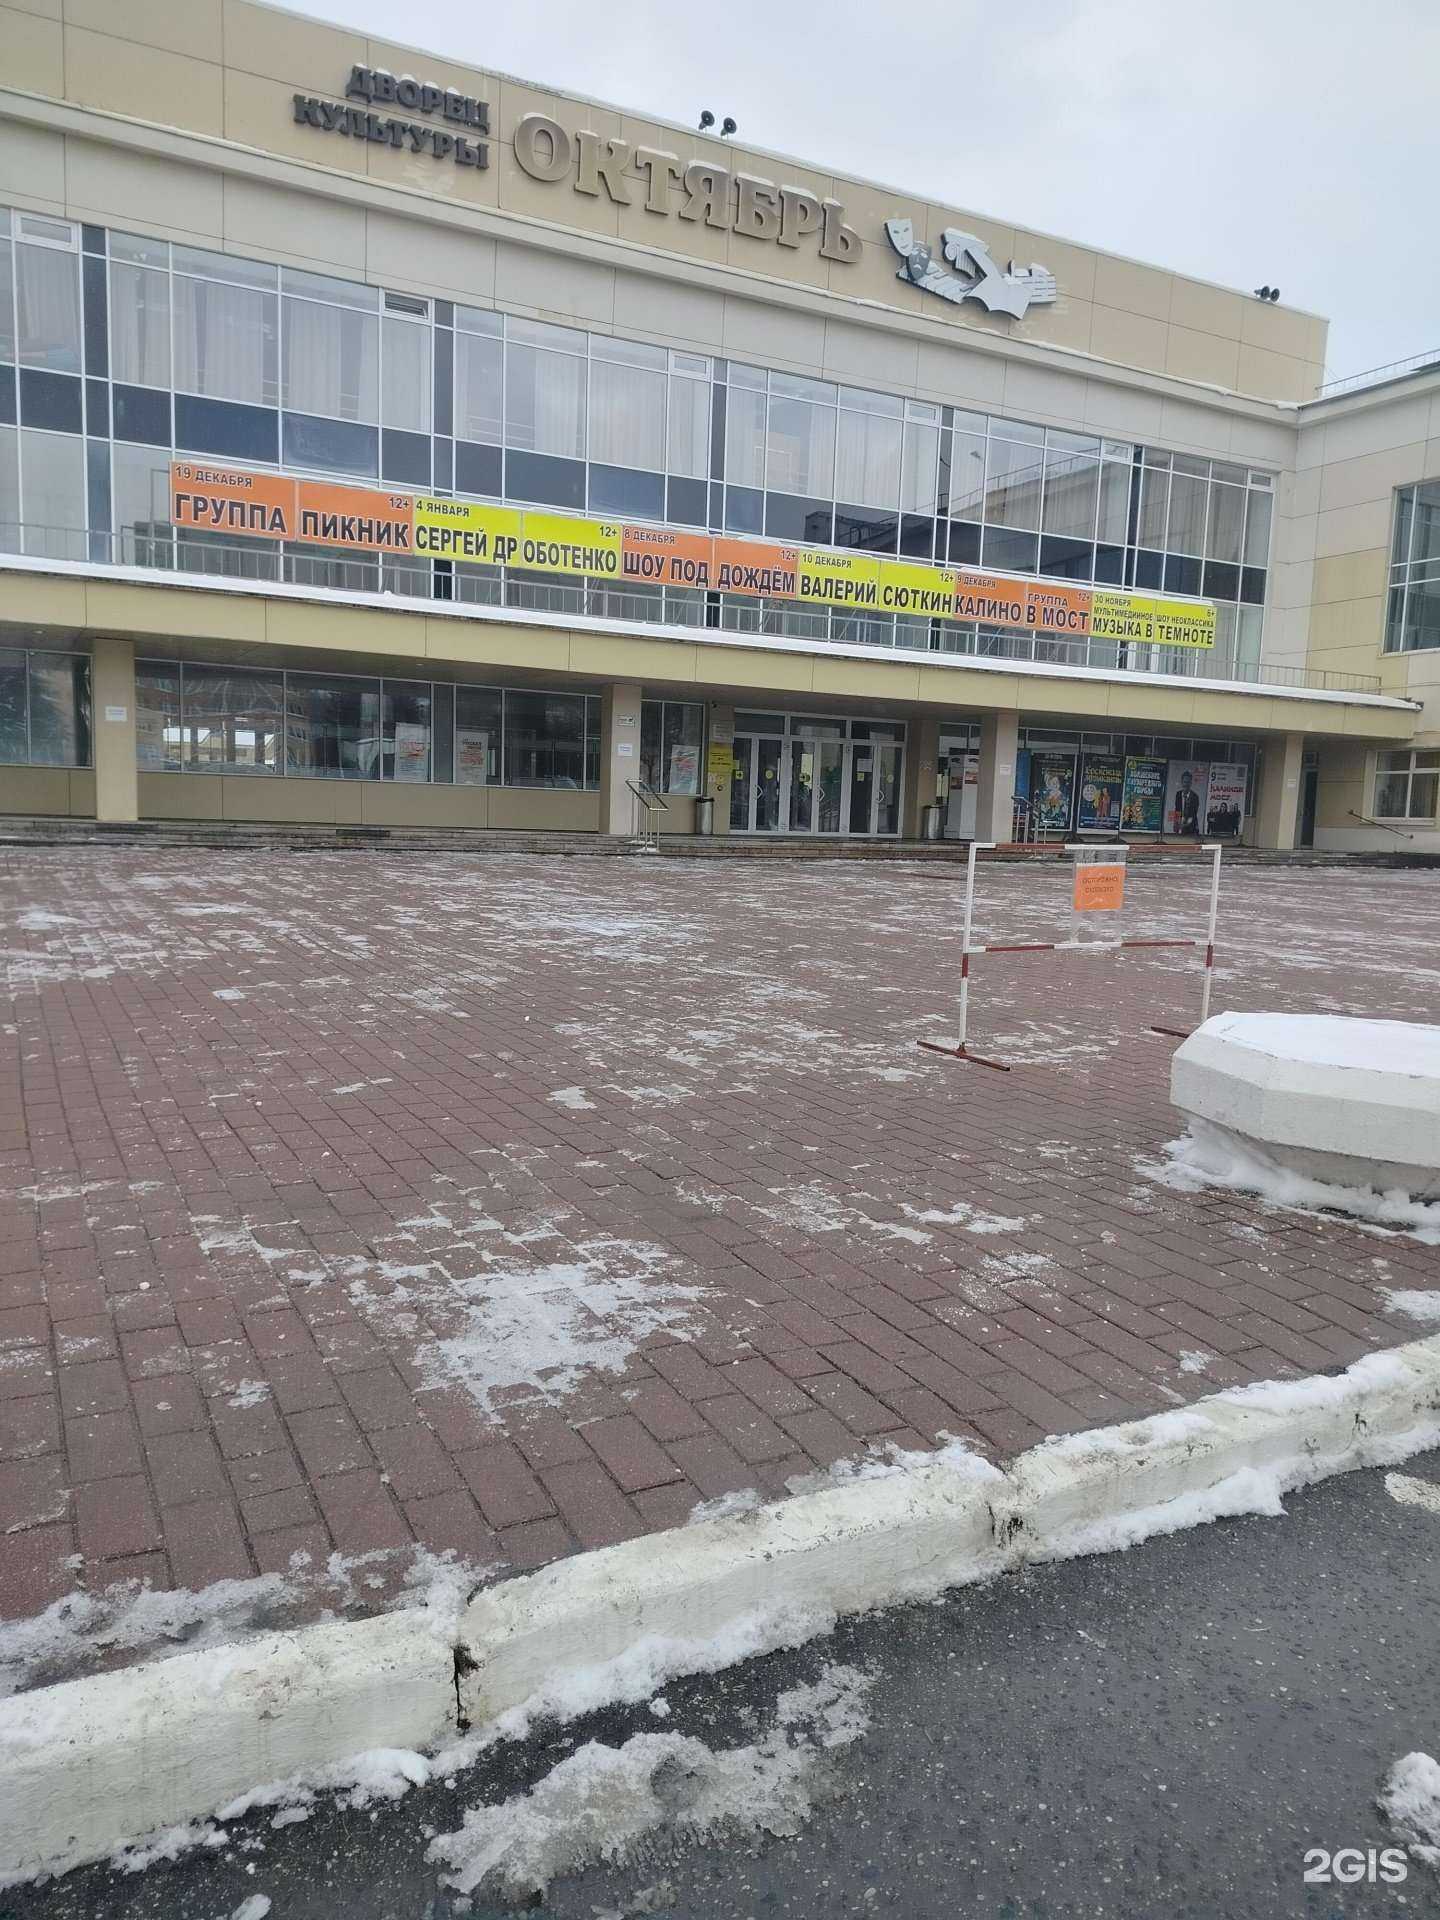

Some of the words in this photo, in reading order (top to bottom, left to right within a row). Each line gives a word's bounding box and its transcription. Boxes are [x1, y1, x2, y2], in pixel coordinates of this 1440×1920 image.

[346, 64, 490, 135] ДВОРЕЦ
[293, 94, 489, 170] КУЛЬТУРЫ
[514, 112, 864, 264] ОКТЯБРЬ
[176, 466, 190, 479] 19
[195, 470, 252, 488] ДЕКАБРЯ
[389, 497, 409, 509] 12+
[416, 500, 423, 510] 4
[426, 502, 470, 517] ЯНВАРЯ
[175, 493, 287, 533] ГРУППА
[302, 510, 409, 548] ПИКНИК
[600, 526, 617, 537] 12+
[624, 529, 630, 539] 8
[634, 531, 675, 544] ДЕКАБРЯ
[416, 525, 487, 557] СЕРГЕЙ
[781, 551, 796, 561] 12+
[803, 554, 812, 563] 10
[815, 557, 851, 568] ДЕКАБРЯ
[623, 551, 666, 578] ШОУ
[671, 557, 709, 588] ПОД
[718, 563, 795, 594] ДОЖДЁМ
[940, 572, 954, 583] 12+
[964, 576, 996, 589] ДЕКАБРЯ
[801, 575, 876, 604] ВАЛЕРИЙ
[883, 585, 951, 613] СЮТКИН
[1028, 593, 1068, 607] ГРУППА
[1105, 597, 1131, 607] НОЯБРЯ
[1042, 607, 1089, 630] МОСТ
[1156, 614, 1170, 623] ШОУ
[1092, 617, 1141, 637] МУЗЫКА
[1146, 623, 1152, 638] В
[1158, 625, 1213, 645] ТЕМНОТЕ
